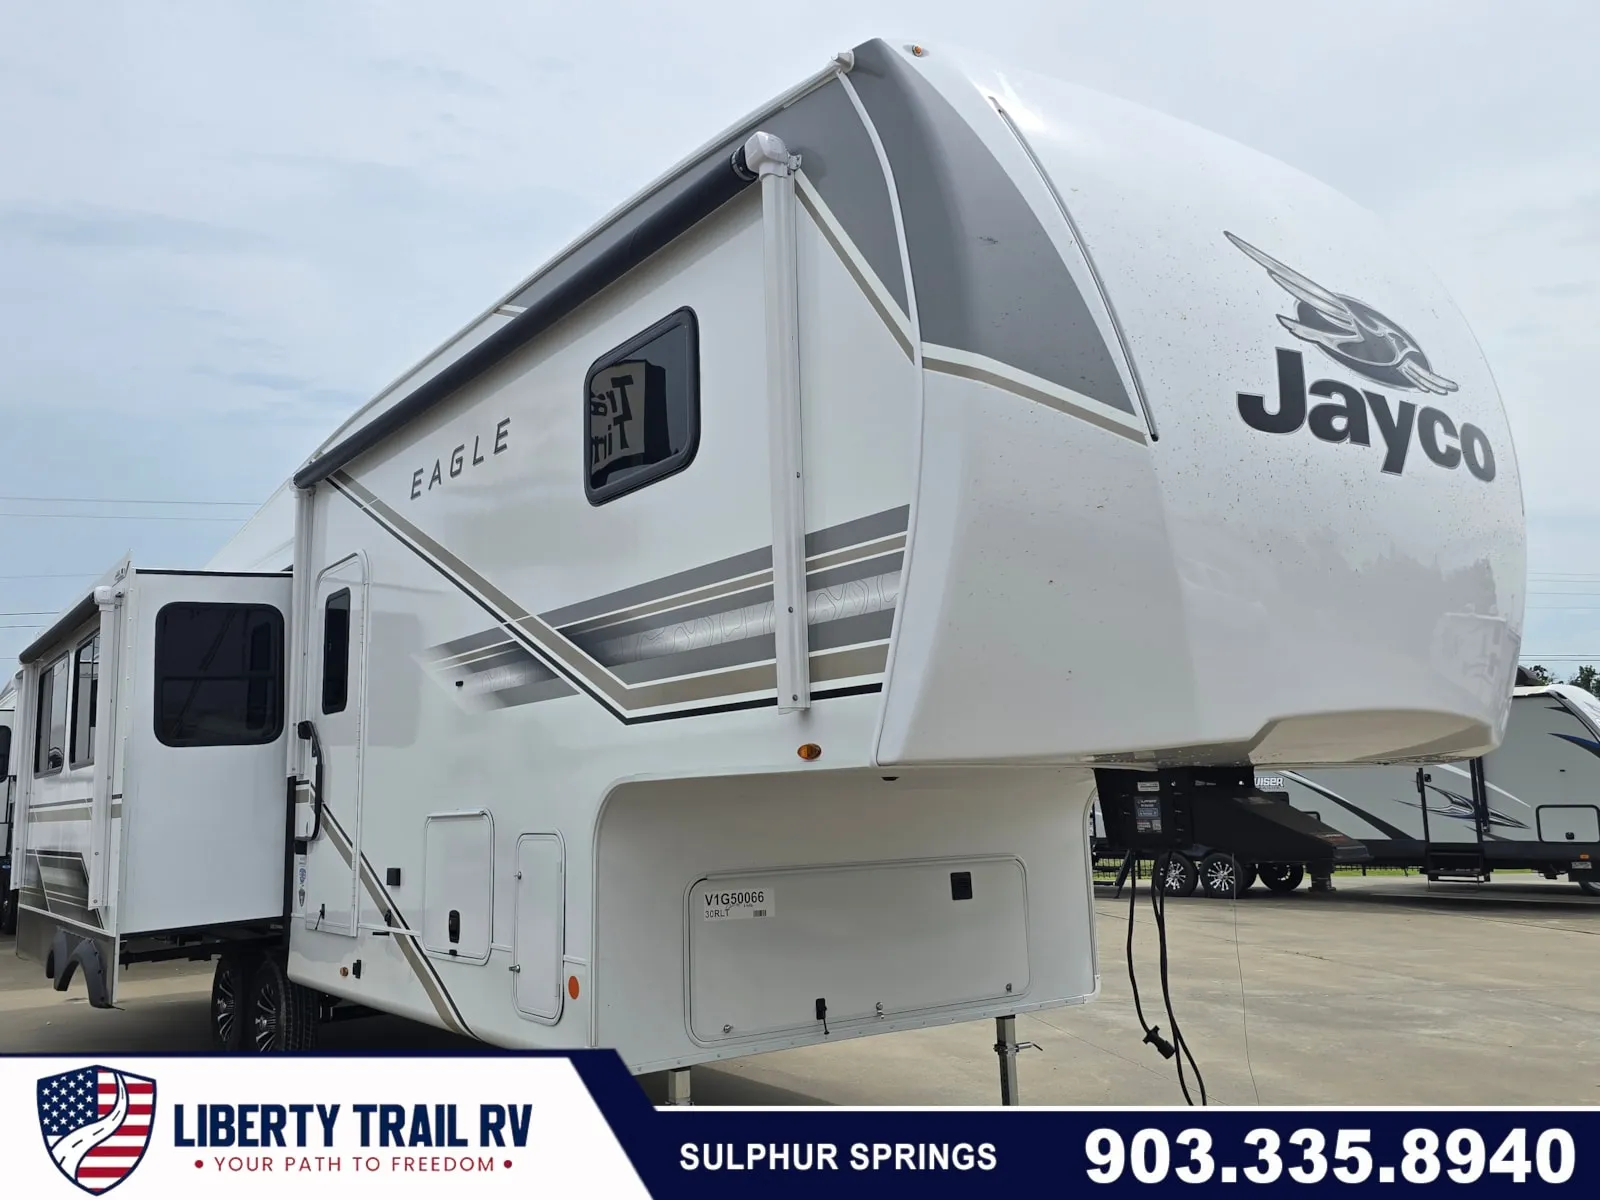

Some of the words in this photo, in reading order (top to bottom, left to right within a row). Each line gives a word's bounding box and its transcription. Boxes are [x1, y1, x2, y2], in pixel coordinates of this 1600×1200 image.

[1236, 346, 1496, 483] Jayco
[410, 417, 511, 501] EAGLE
[704, 891, 765, 906] V1G50066
